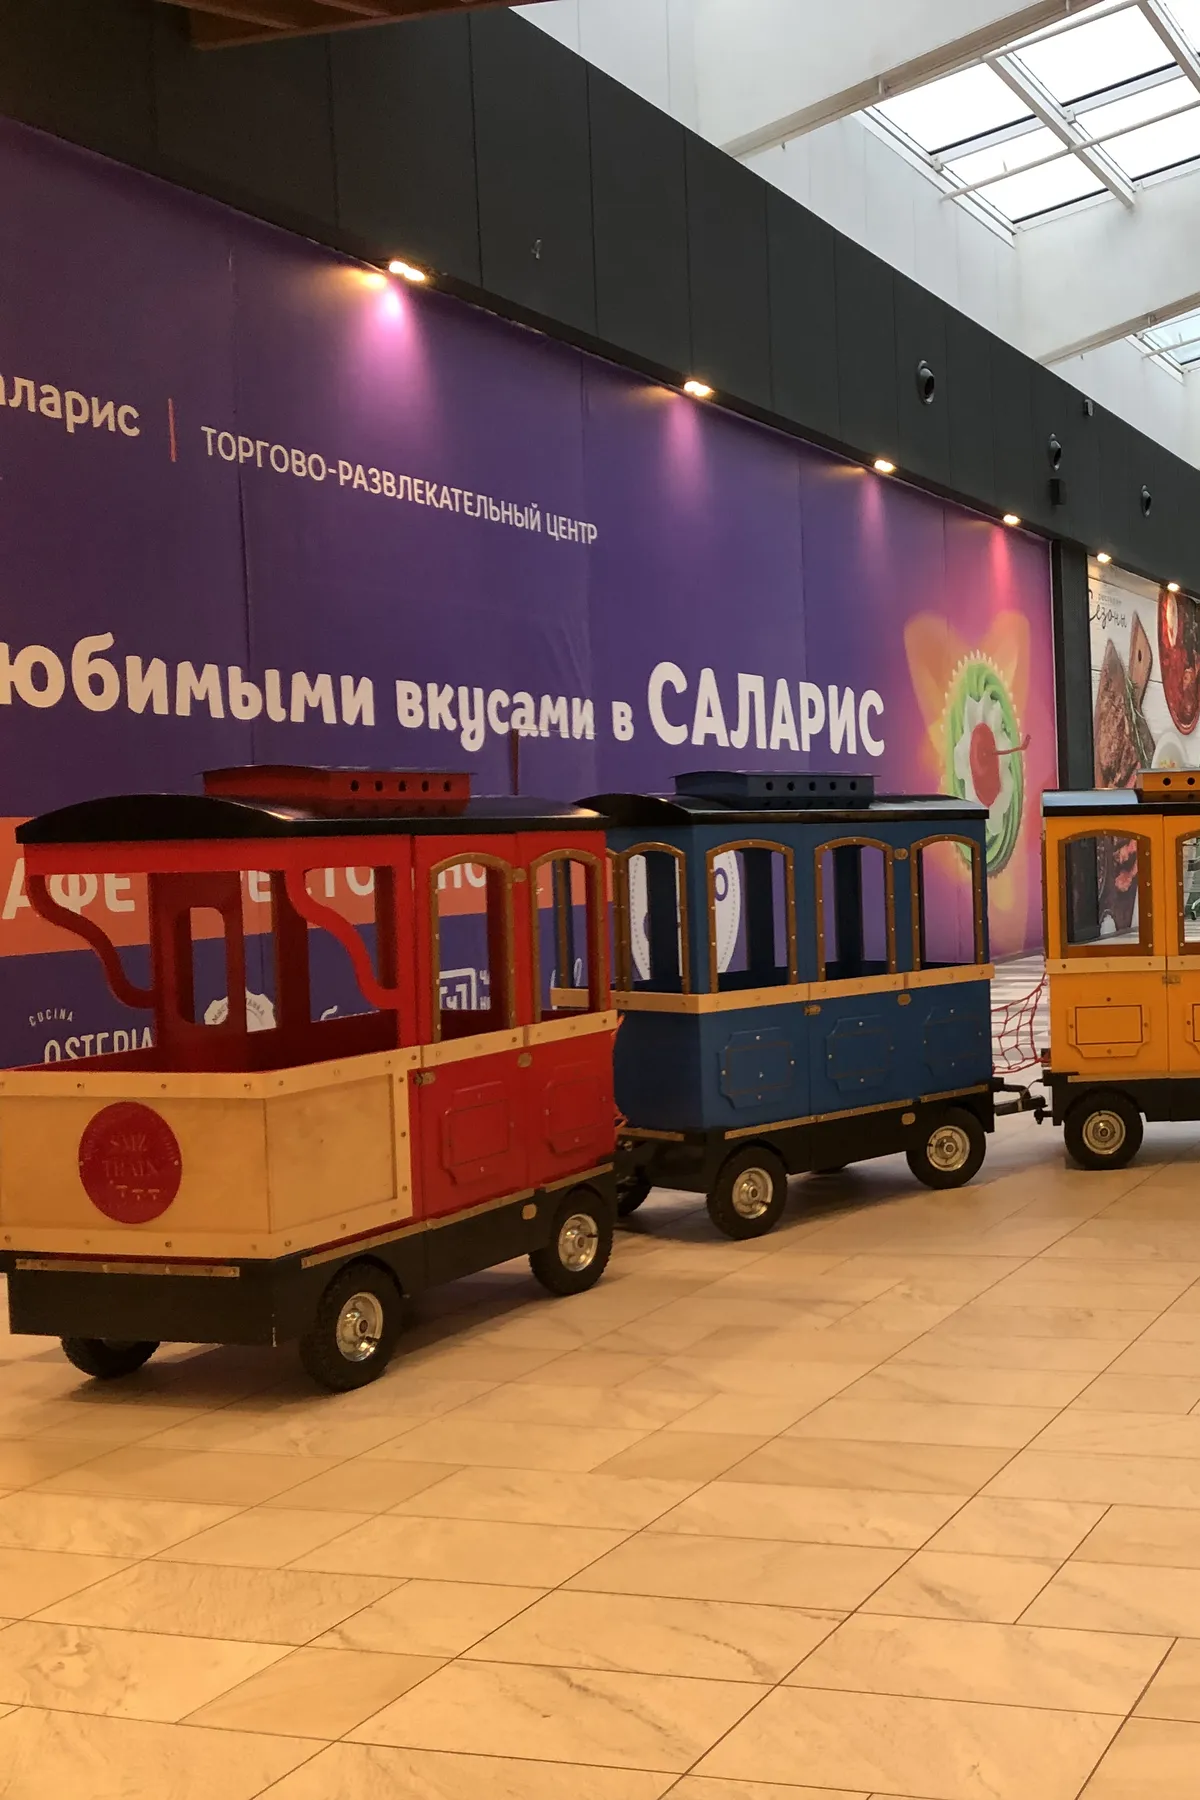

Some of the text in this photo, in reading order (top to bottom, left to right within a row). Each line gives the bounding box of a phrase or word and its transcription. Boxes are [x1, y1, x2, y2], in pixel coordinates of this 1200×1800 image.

[201, 425, 598, 545] ТОРГОВО-РАЗВЛЕКАТЕЛЬНЫЙ ЦЕНТР
[0, 631, 886, 757] юбимыми вкусами в САЛАРИС
[28, 1007, 74, 1027] CUCINA
